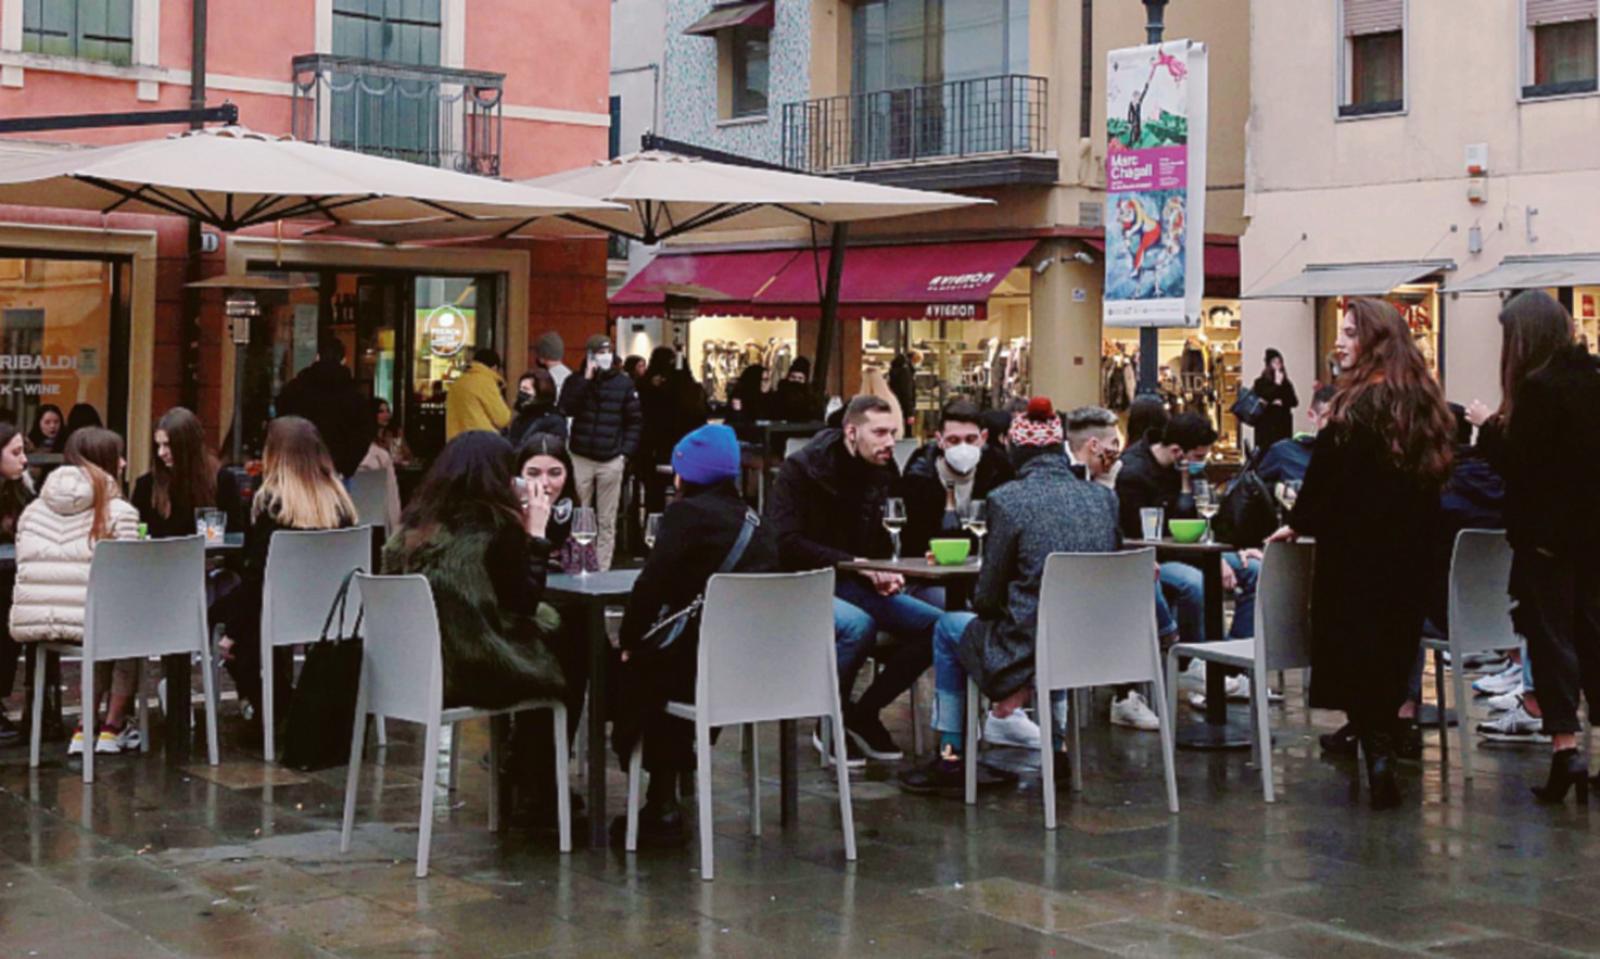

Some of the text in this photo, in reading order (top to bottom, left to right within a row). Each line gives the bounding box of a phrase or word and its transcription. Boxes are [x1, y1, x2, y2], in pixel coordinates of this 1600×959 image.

[1111, 155, 1138, 167] Marc
[1111, 164, 1153, 180] Chagall
[926, 304, 975, 317] AVIGNON
[0, 355, 77, 369] RIBALDI
[24, 384, 61, 395] WINE
